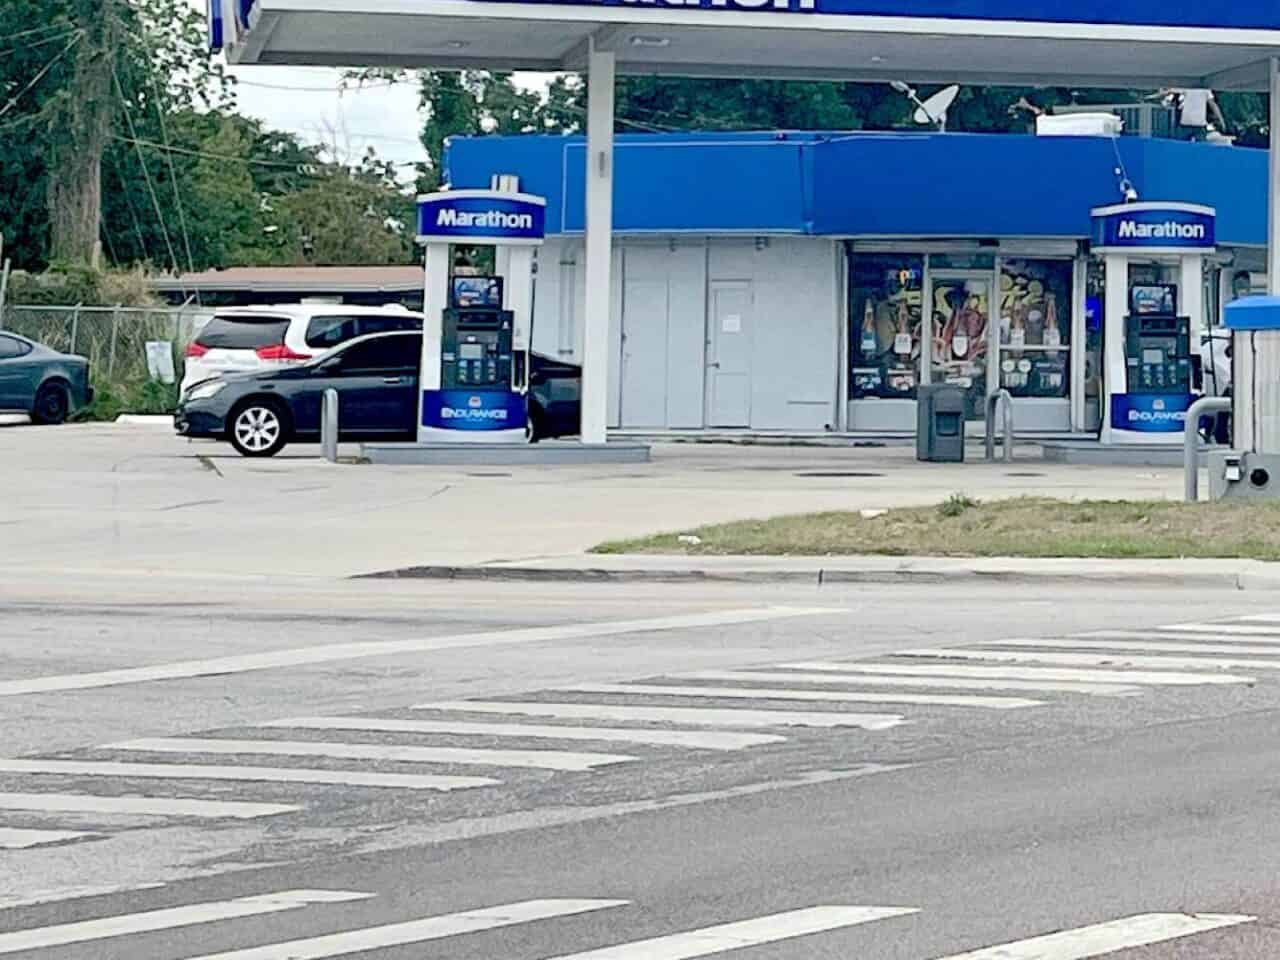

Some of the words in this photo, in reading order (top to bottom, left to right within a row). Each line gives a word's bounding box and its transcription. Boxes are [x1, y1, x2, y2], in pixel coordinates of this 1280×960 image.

[436, 208, 533, 229] Marathon
[1118, 220, 1205, 239] Marathon
[1128, 410, 1187, 422] ENDURANC
